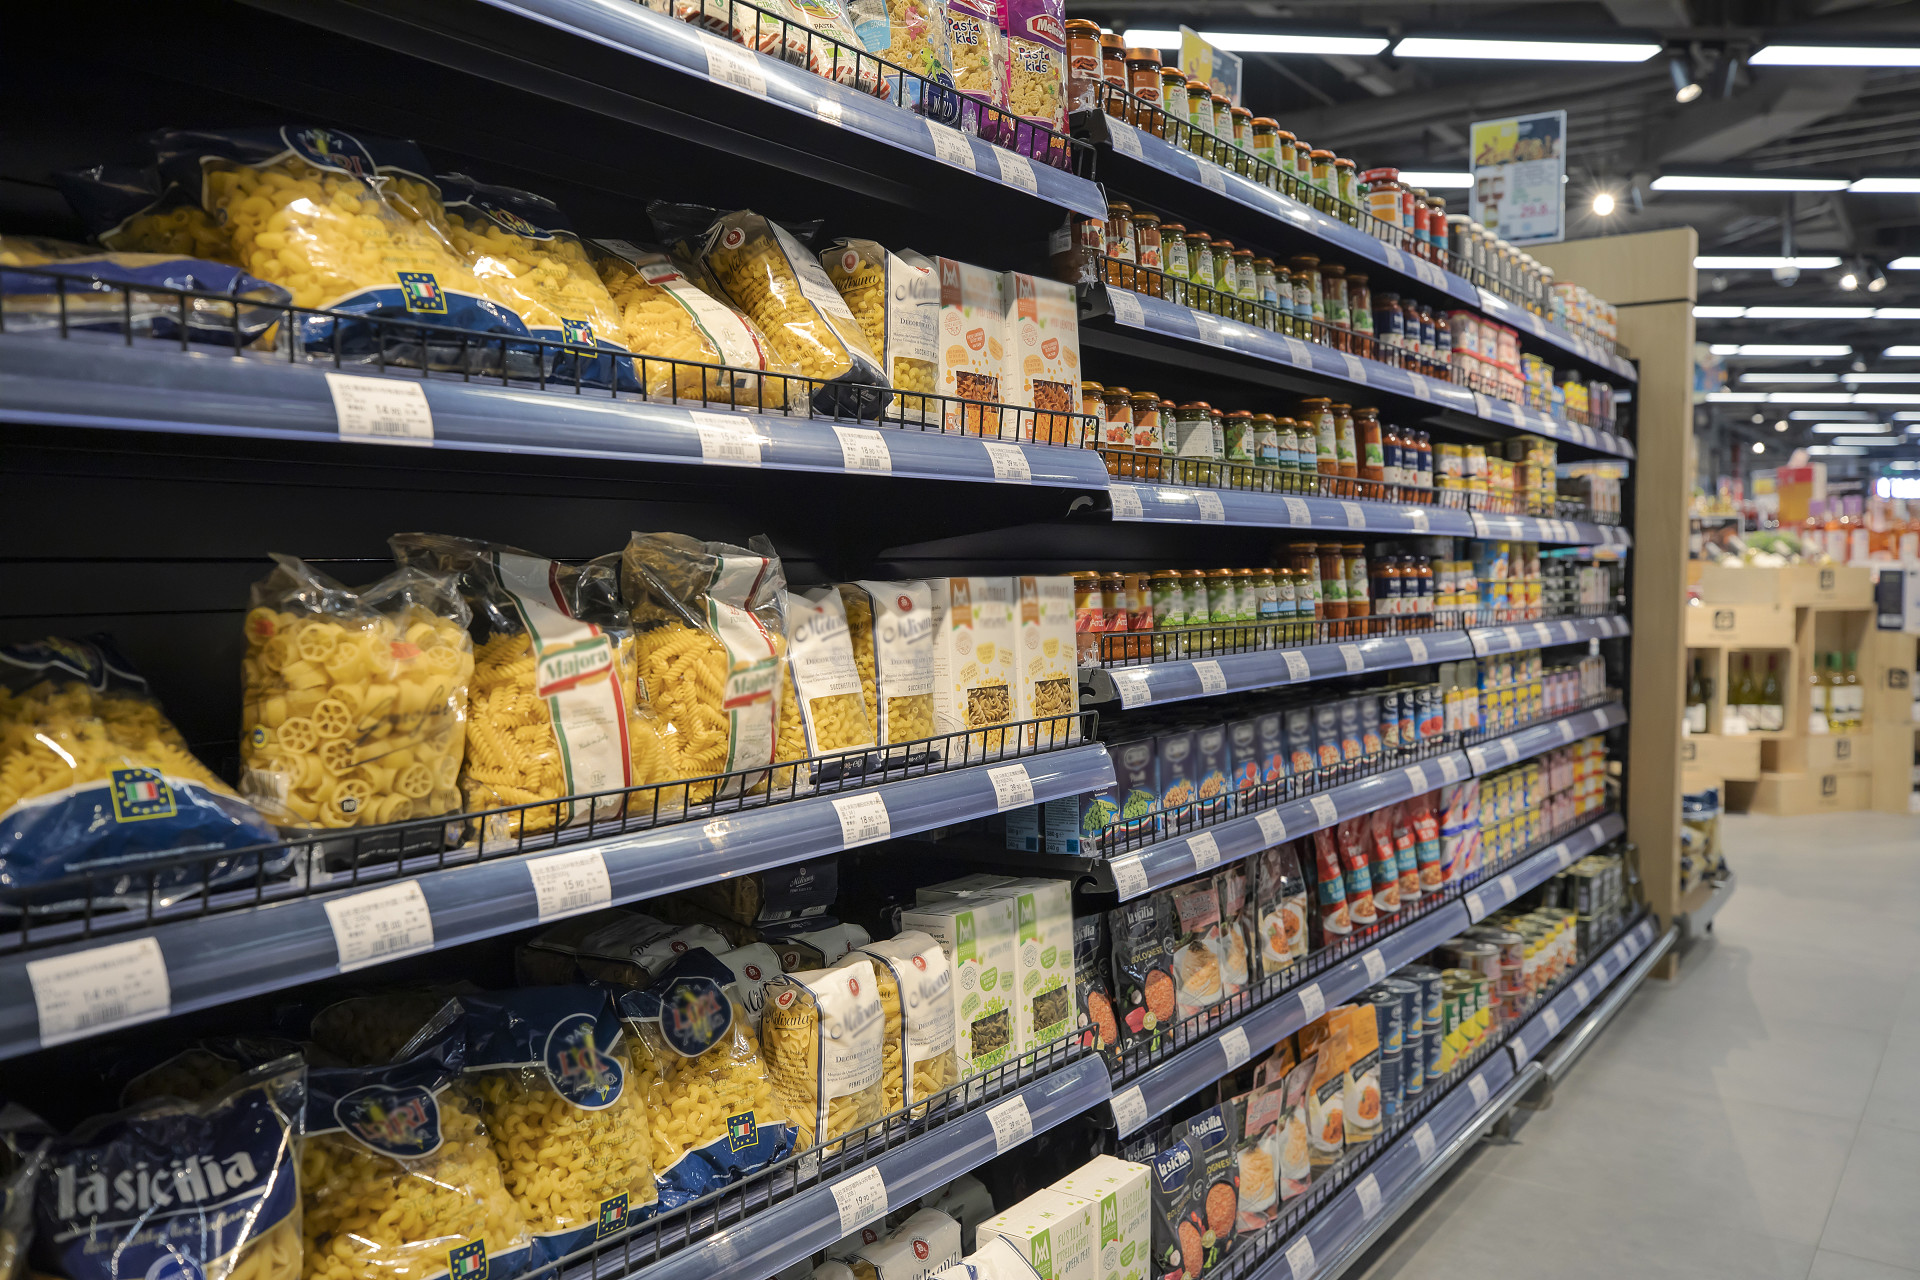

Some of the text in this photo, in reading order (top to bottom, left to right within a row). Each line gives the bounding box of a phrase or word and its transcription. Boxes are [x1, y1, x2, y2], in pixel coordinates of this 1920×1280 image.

[948, 18, 981, 33] Pasta
[955, 31, 979, 45] kids
[1018, 47, 1050, 62] Pasta
[1025, 60, 1048, 73] kids
[545, 648, 609, 681] Majora
